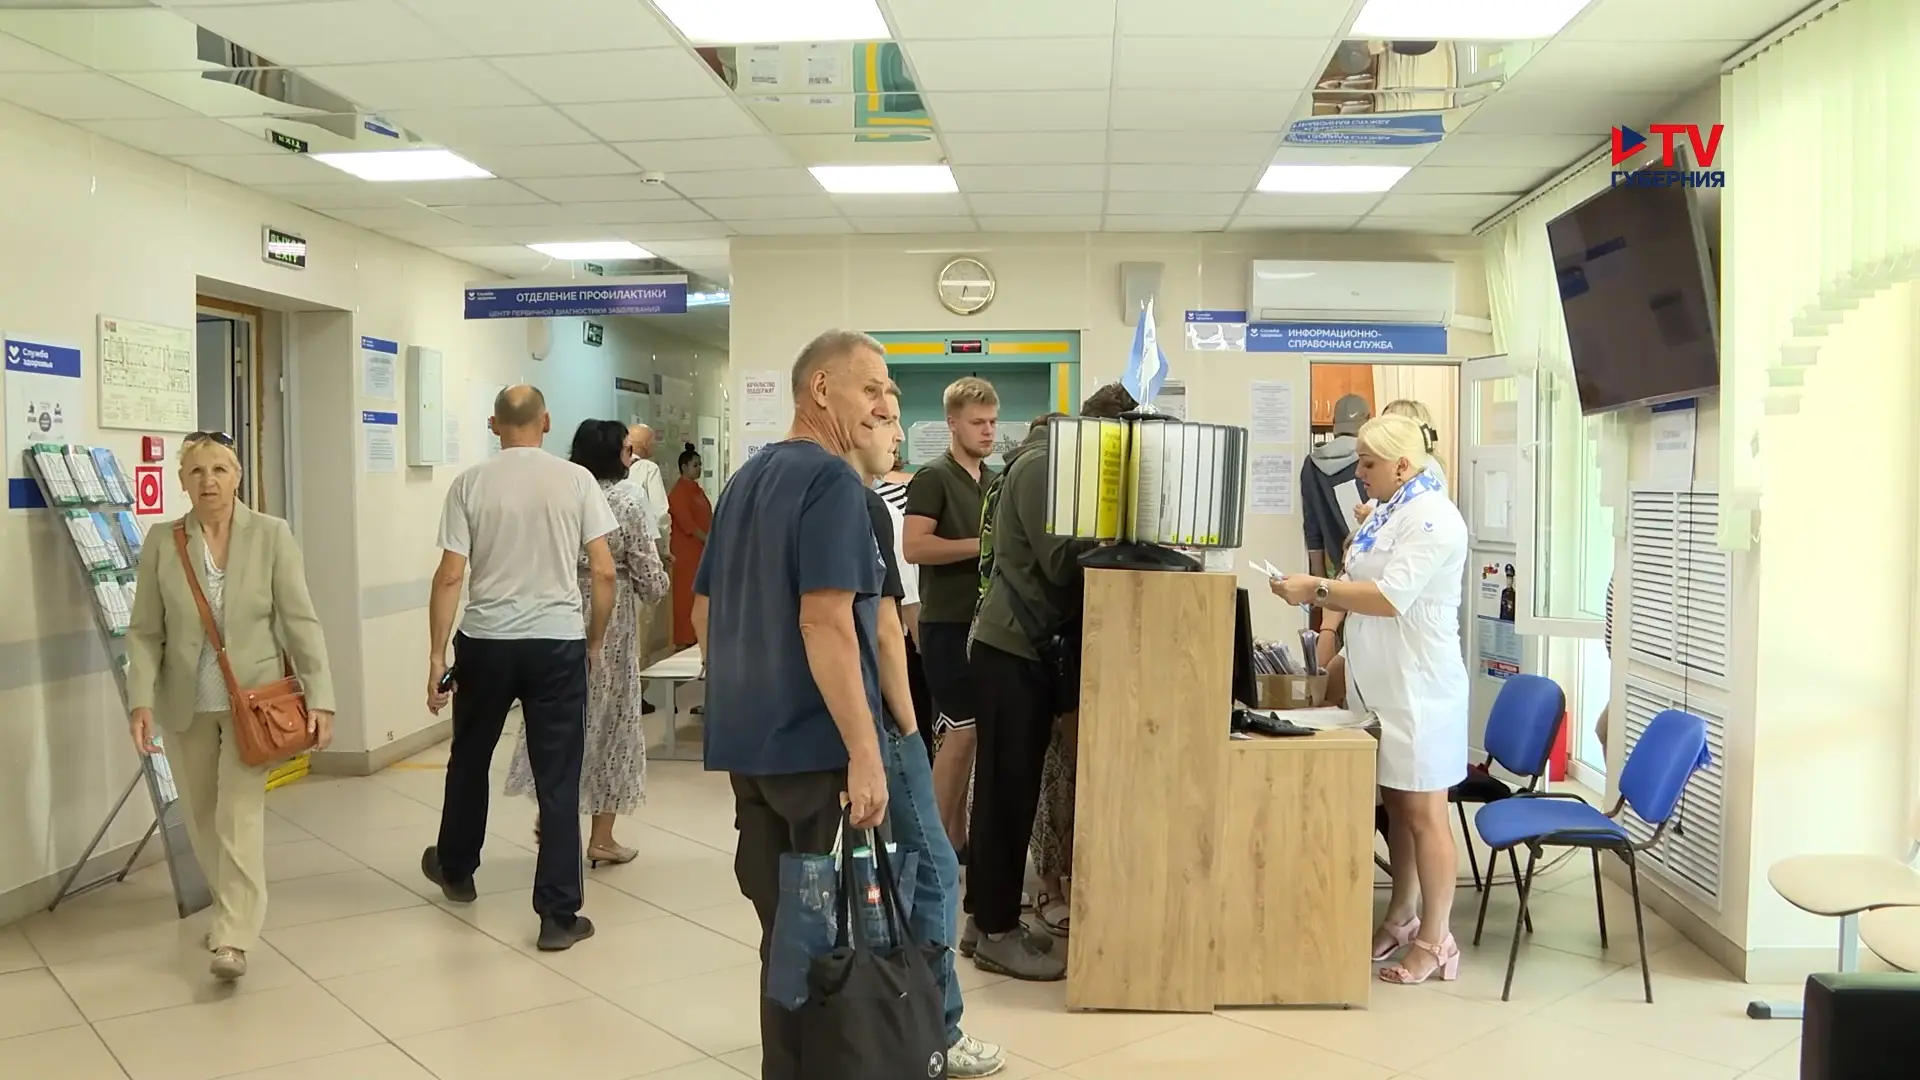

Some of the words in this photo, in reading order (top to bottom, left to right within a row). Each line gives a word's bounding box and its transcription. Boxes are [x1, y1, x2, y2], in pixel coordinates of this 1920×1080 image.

[516, 291, 577, 303] ОТДЕЛЕНИЕ
[580, 289, 667, 300] ПРОФИЛАКТИКИ
[511, 308, 553, 316] ПЕРВИЧНОЙ
[554, 307, 607, 315] ДИАГНОСТИКИ
[608, 305, 660, 314] ЗАБОЛЕВАНИЙ
[1288, 328, 1382, 339] ИНФОРМАЦИОННО-
[1288, 339, 1351, 349] СПРАВОЧНАЯ
[1353, 340, 1393, 350] СЛУЖБА
